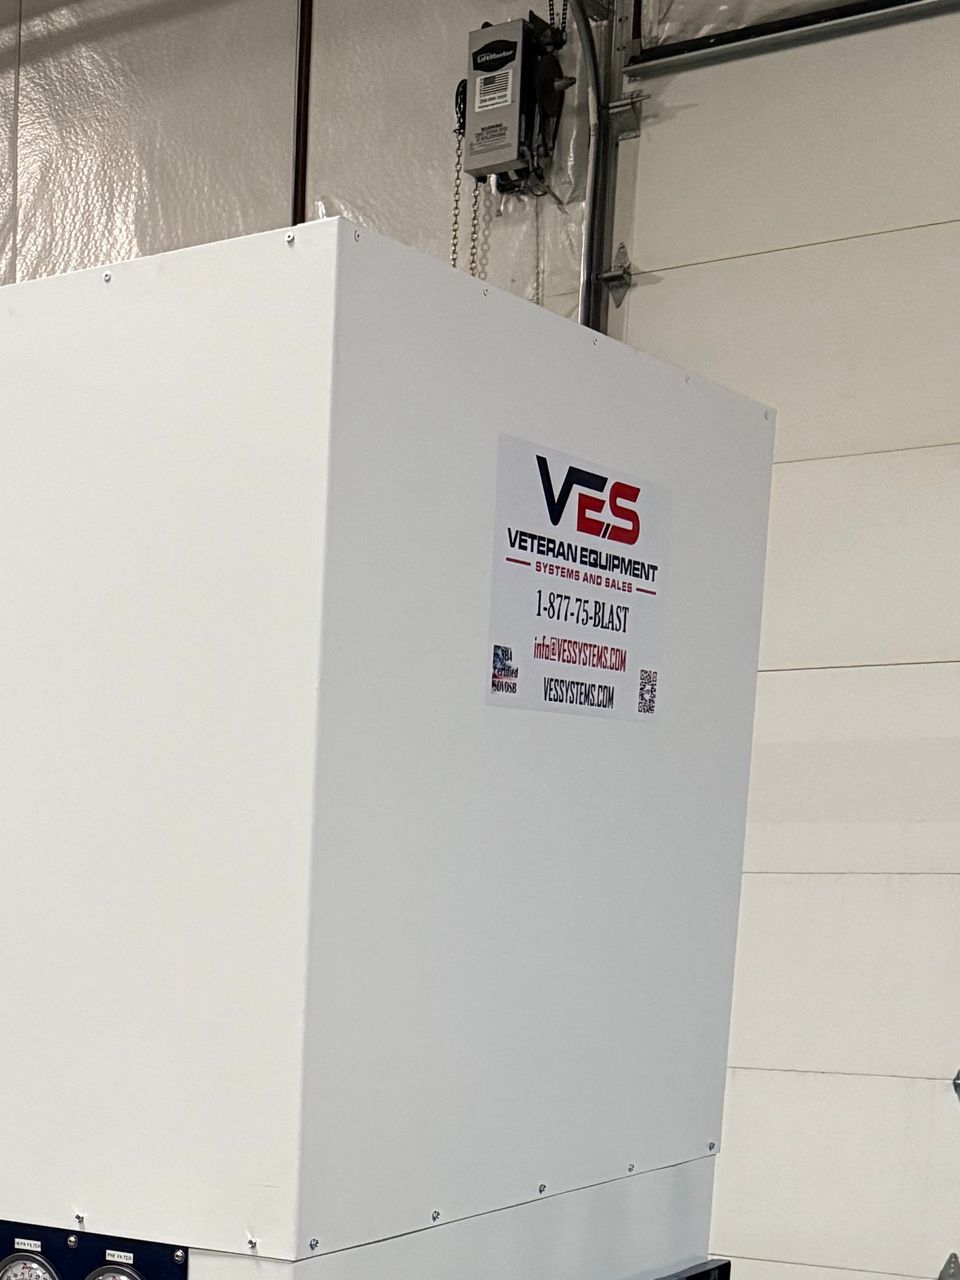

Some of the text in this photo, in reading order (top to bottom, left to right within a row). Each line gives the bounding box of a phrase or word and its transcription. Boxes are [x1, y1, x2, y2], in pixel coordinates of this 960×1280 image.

[536, 454, 641, 546] VES
[507, 528, 658, 582] VETERAN EQUIPMENT
[535, 560, 633, 593] SYSTEMS AND SALES
[536, 590, 629, 633] 1-877-75-BLAST
[534, 636, 627, 672] info@VESSYSTEMS.COM
[543, 677, 614, 709] VESSYSTEMS.COM
